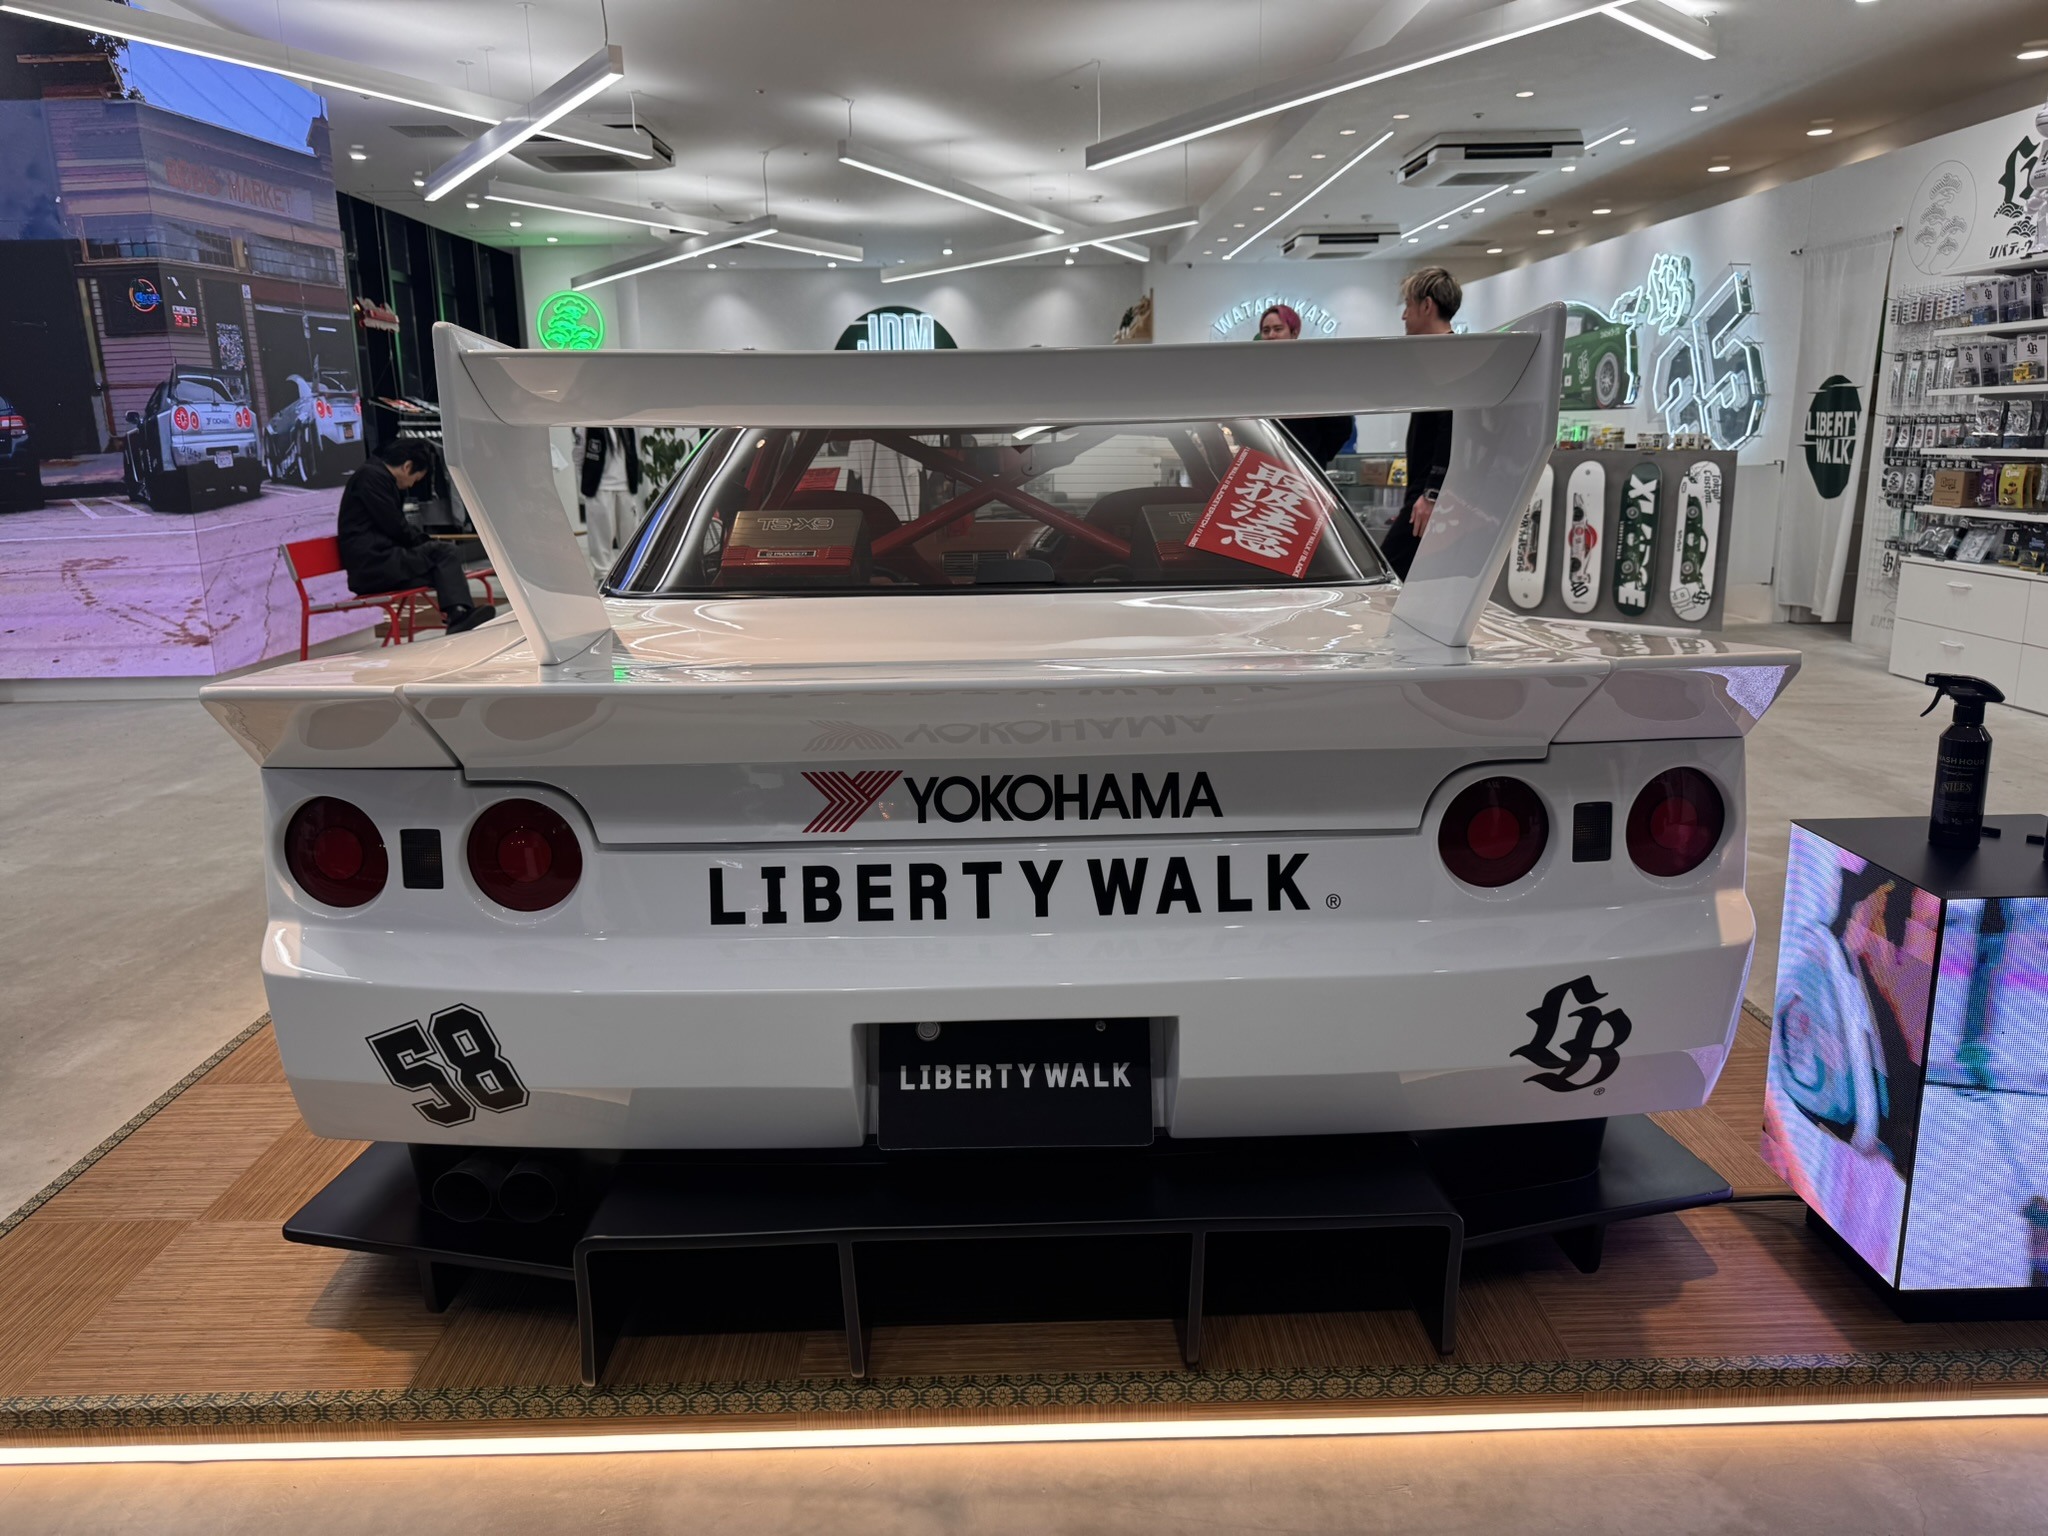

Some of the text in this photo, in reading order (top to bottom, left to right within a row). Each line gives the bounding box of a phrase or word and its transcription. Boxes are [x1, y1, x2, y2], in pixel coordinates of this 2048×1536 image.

[1989, 240, 2034, 259] リバティーウ
[1293, 298, 1338, 334] KATO
[1805, 411, 1862, 438] LIBERTY
[1815, 438, 1852, 465] WALK
[757, 517, 835, 531] TS-X9
[1958, 757, 1985, 766] HOUR
[903, 771, 1224, 824] YOKOHAMA
[709, 859, 1064, 925] LIBERTY
[1086, 853, 1311, 916] WALK
[364, 1002, 531, 1129] 58
[900, 1062, 1132, 1090] LIBERTY WALK
